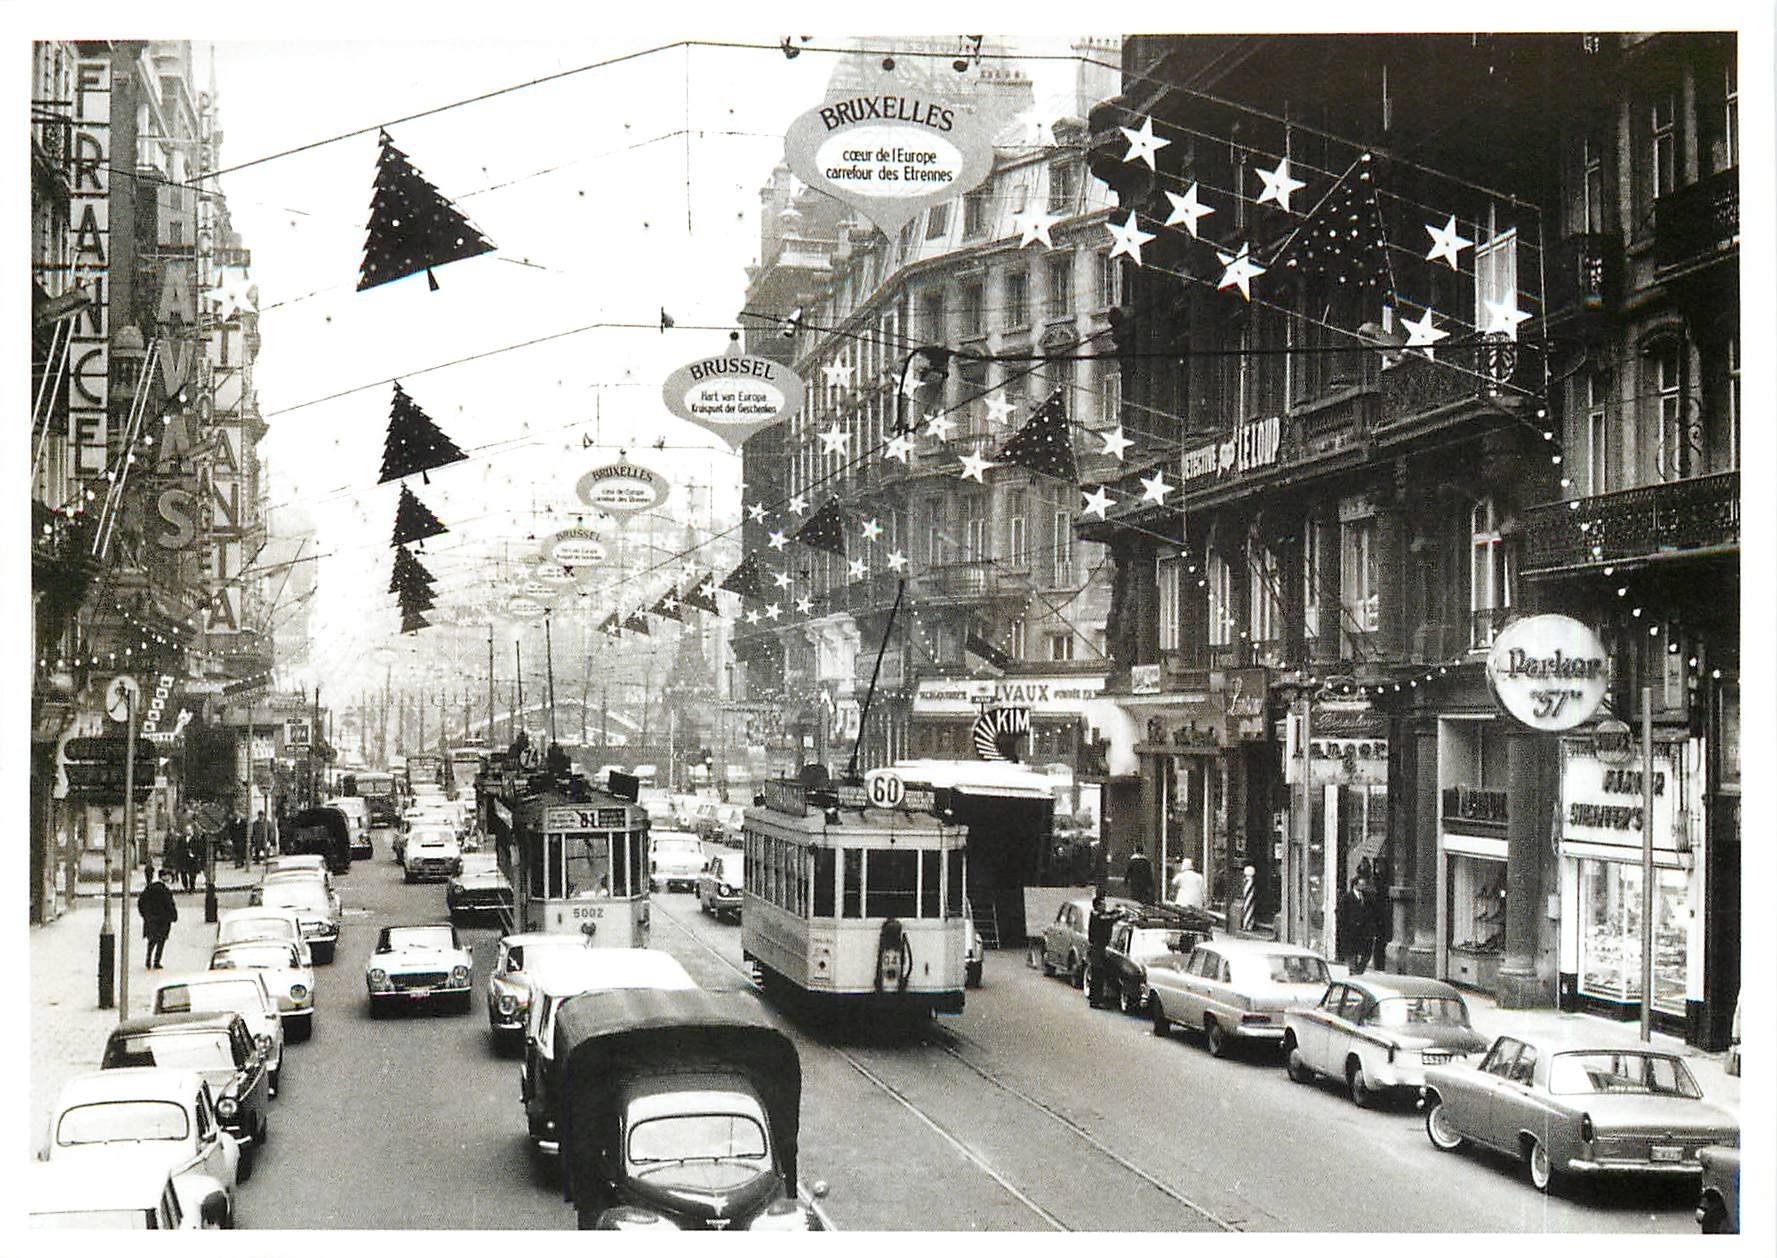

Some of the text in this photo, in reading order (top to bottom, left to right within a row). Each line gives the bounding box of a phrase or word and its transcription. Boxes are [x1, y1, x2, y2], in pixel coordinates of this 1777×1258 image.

[820, 96, 954, 132] BRUXELLES
[842, 150, 873, 162] cœur
[876, 148, 890, 162] de
[826, 166, 953, 182] carrefour des Etrennes
[75, 64, 106, 475] FRANCE
[689, 358, 776, 381] BRUSSEL
[208, 270, 241, 631] TLANTA
[592, 466, 653, 482] BRUXELLES
[1509, 648, 1602, 679] Parker
[996, 709, 1030, 732] KIM
[874, 776, 899, 803] 60
[1602, 769, 1665, 796] PARKR
[573, 908, 604, 918] 5002
